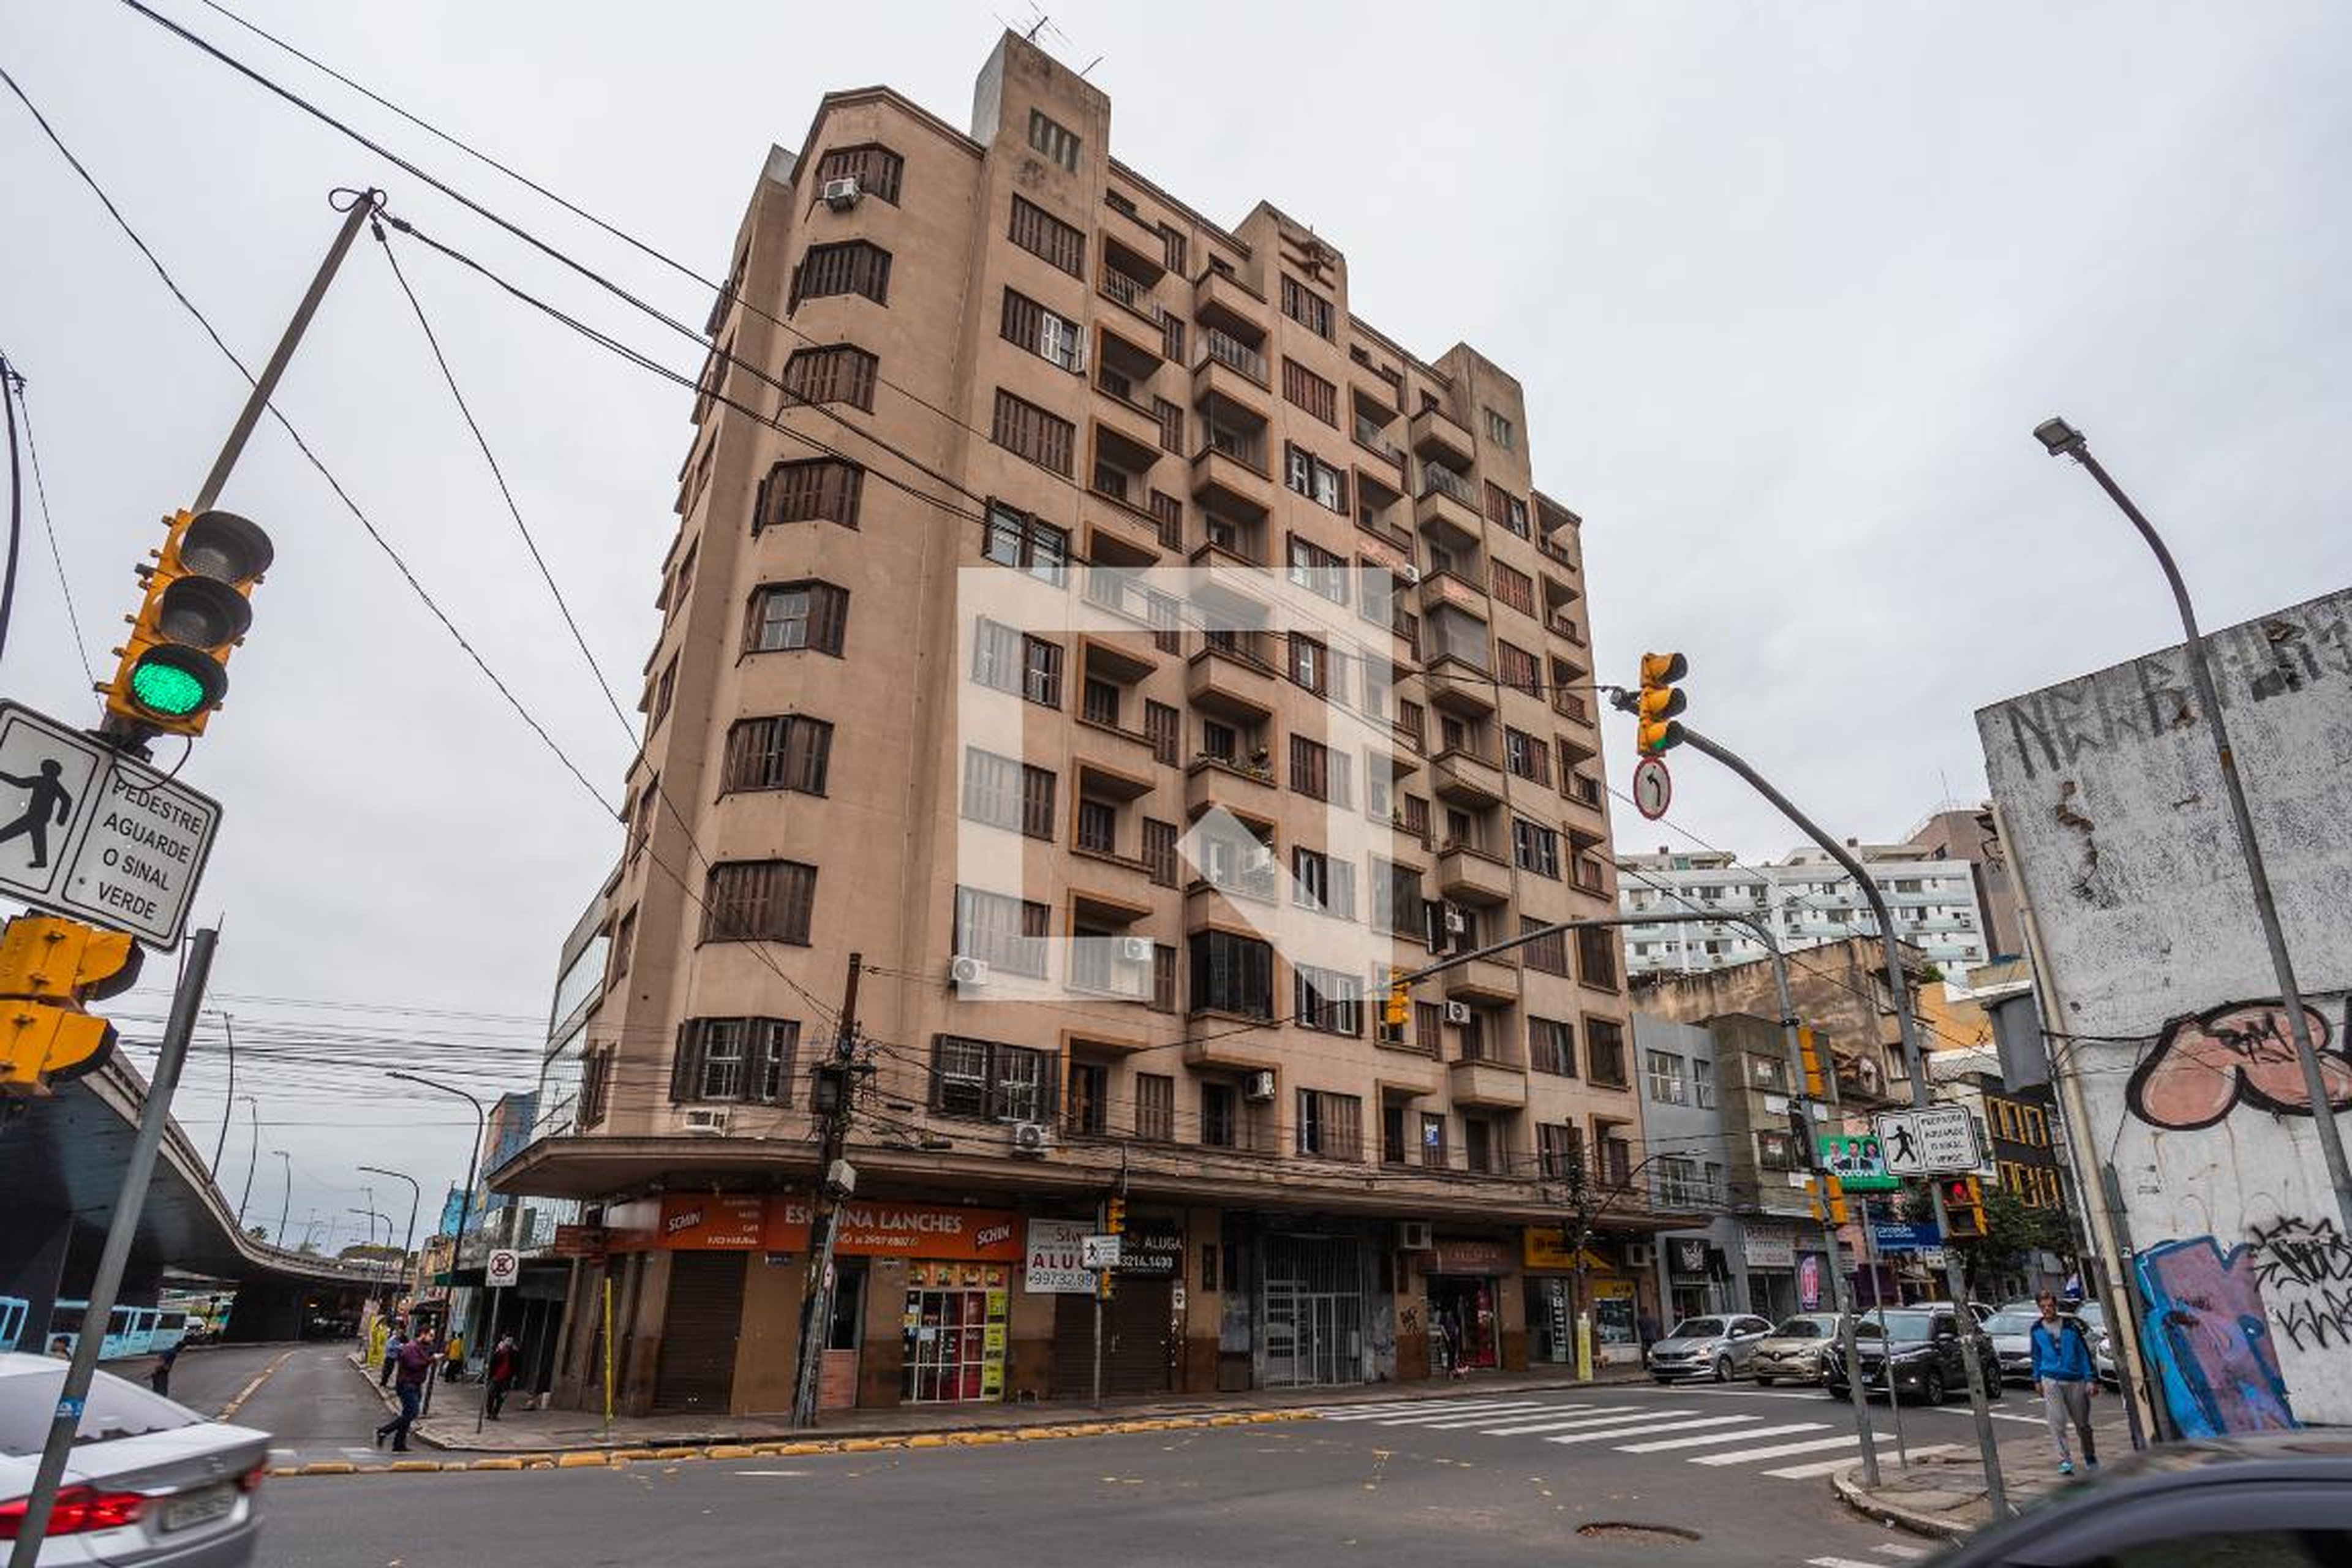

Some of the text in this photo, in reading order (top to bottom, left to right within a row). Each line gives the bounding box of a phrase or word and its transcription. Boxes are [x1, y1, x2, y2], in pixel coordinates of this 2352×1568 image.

[112, 779, 202, 836] PEDESTRE
[103, 812, 192, 864] AGUARDE
[103, 848, 171, 892] O SINAL
[99, 881, 158, 920] VERDE
[880, 1212, 963, 1234] LANCHES
[978, 1225, 1011, 1245] SCHIN
